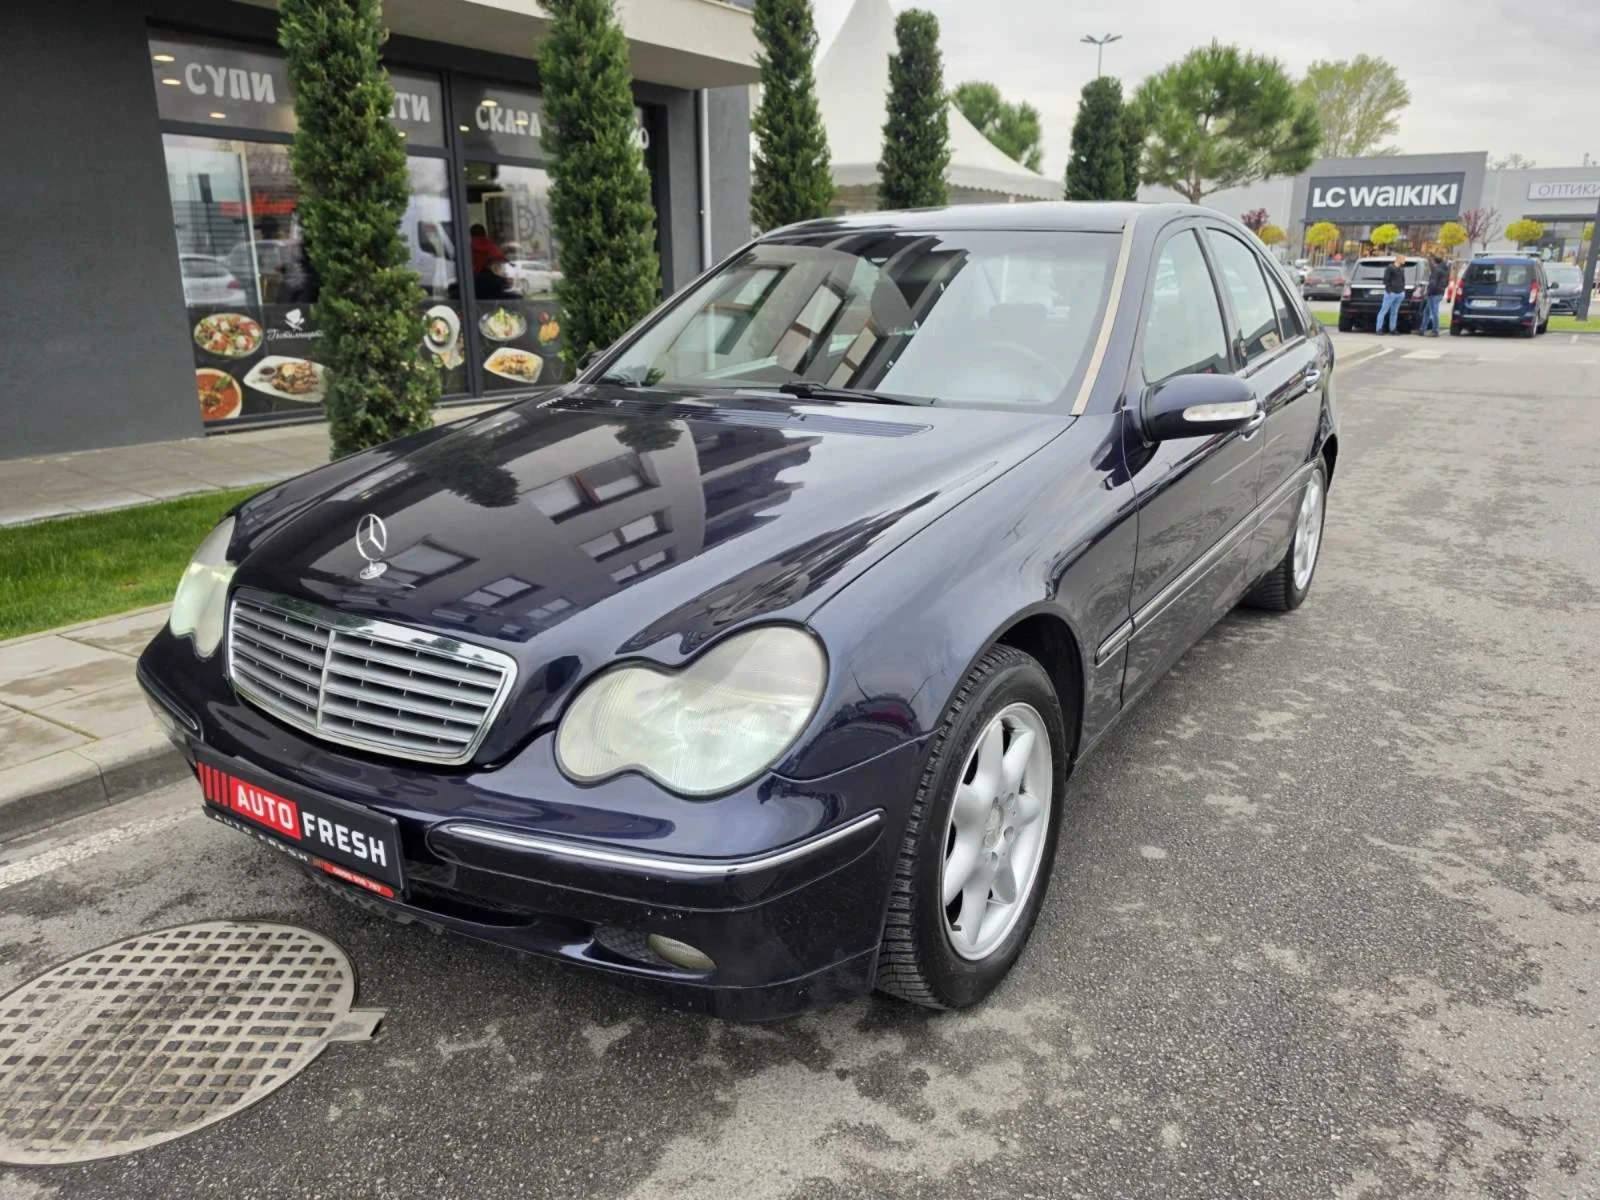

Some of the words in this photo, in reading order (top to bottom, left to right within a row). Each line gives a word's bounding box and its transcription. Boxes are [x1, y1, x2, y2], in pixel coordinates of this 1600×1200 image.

[184, 62, 276, 104] СУПИ
[475, 102, 542, 137] СКАРА
[1312, 187, 1347, 208] LC
[237, 784, 294, 831] AUTO
[301, 811, 387, 868] FRESH
